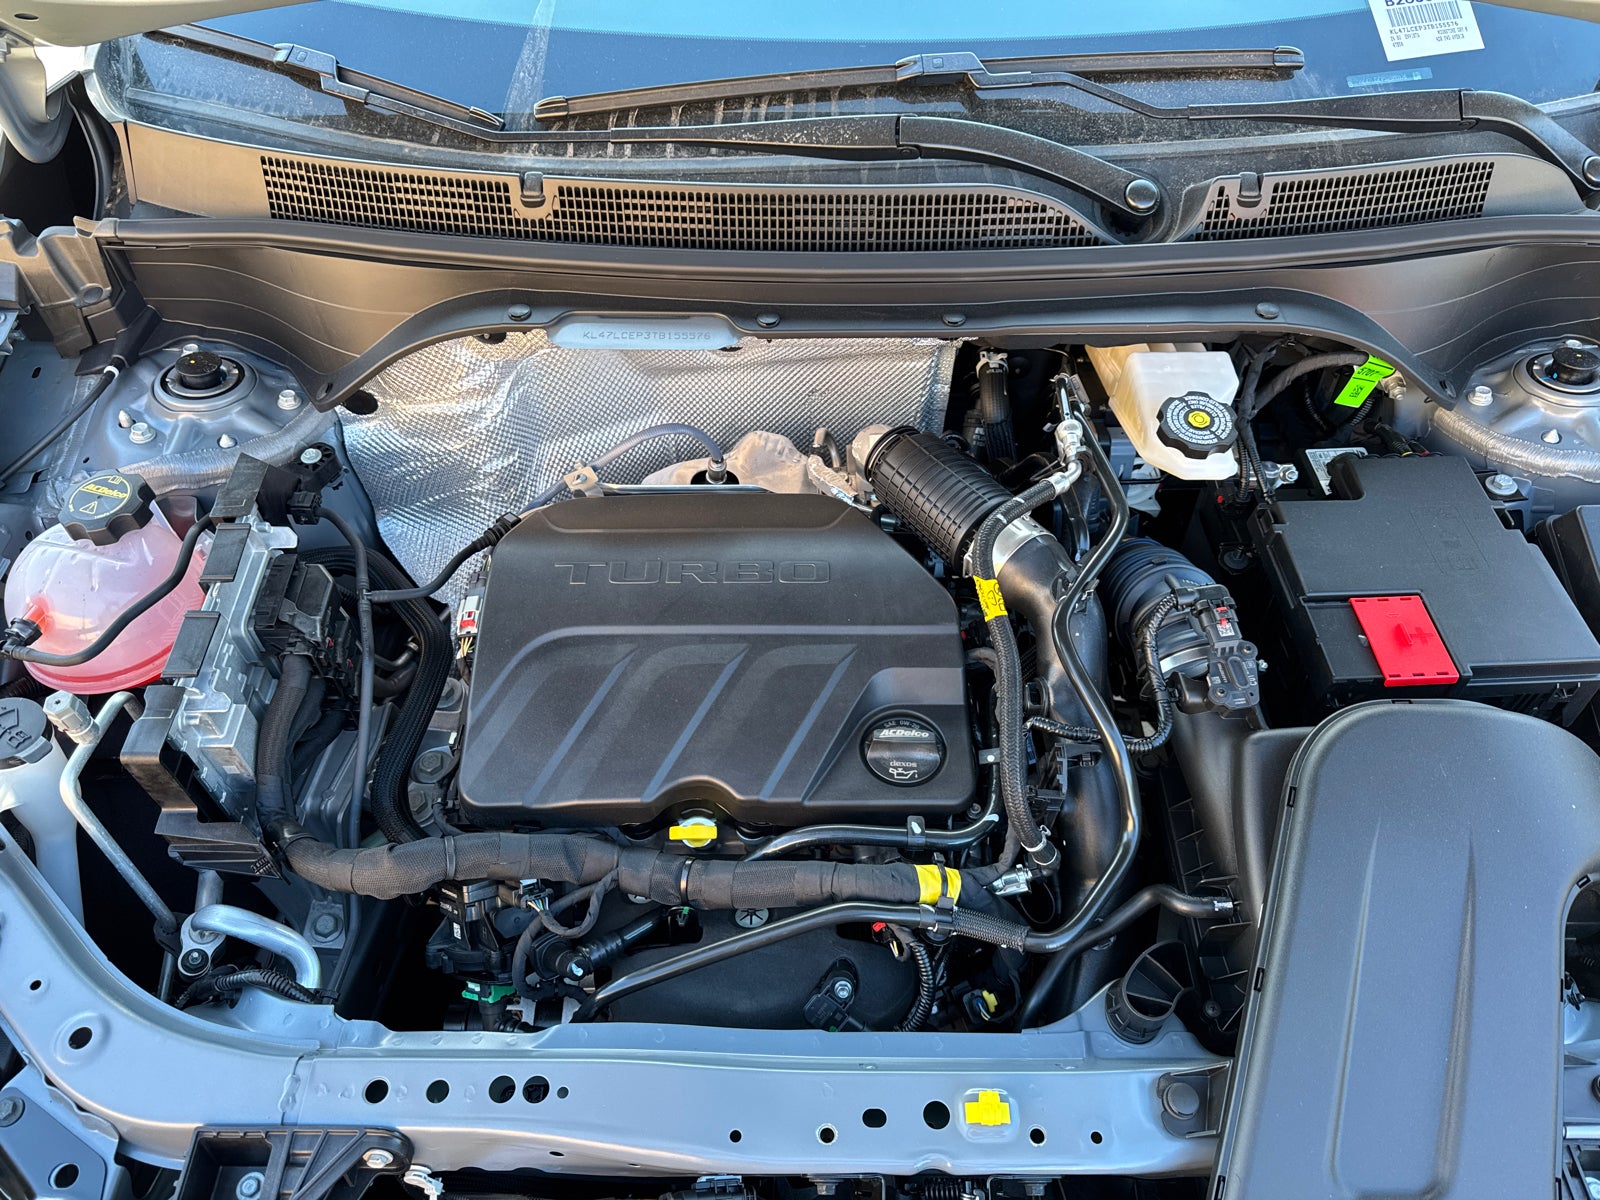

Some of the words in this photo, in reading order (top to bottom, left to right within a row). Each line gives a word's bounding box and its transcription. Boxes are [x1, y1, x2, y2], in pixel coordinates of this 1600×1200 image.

[583, 331, 711, 340] KL47LCEP3TB155576
[80, 484, 128, 499] ACDelco
[554, 560, 831, 584] TURBO
[884, 721, 897, 729] SAE
[879, 729, 929, 738] ACDelco
[890, 760, 917, 768] dexos
